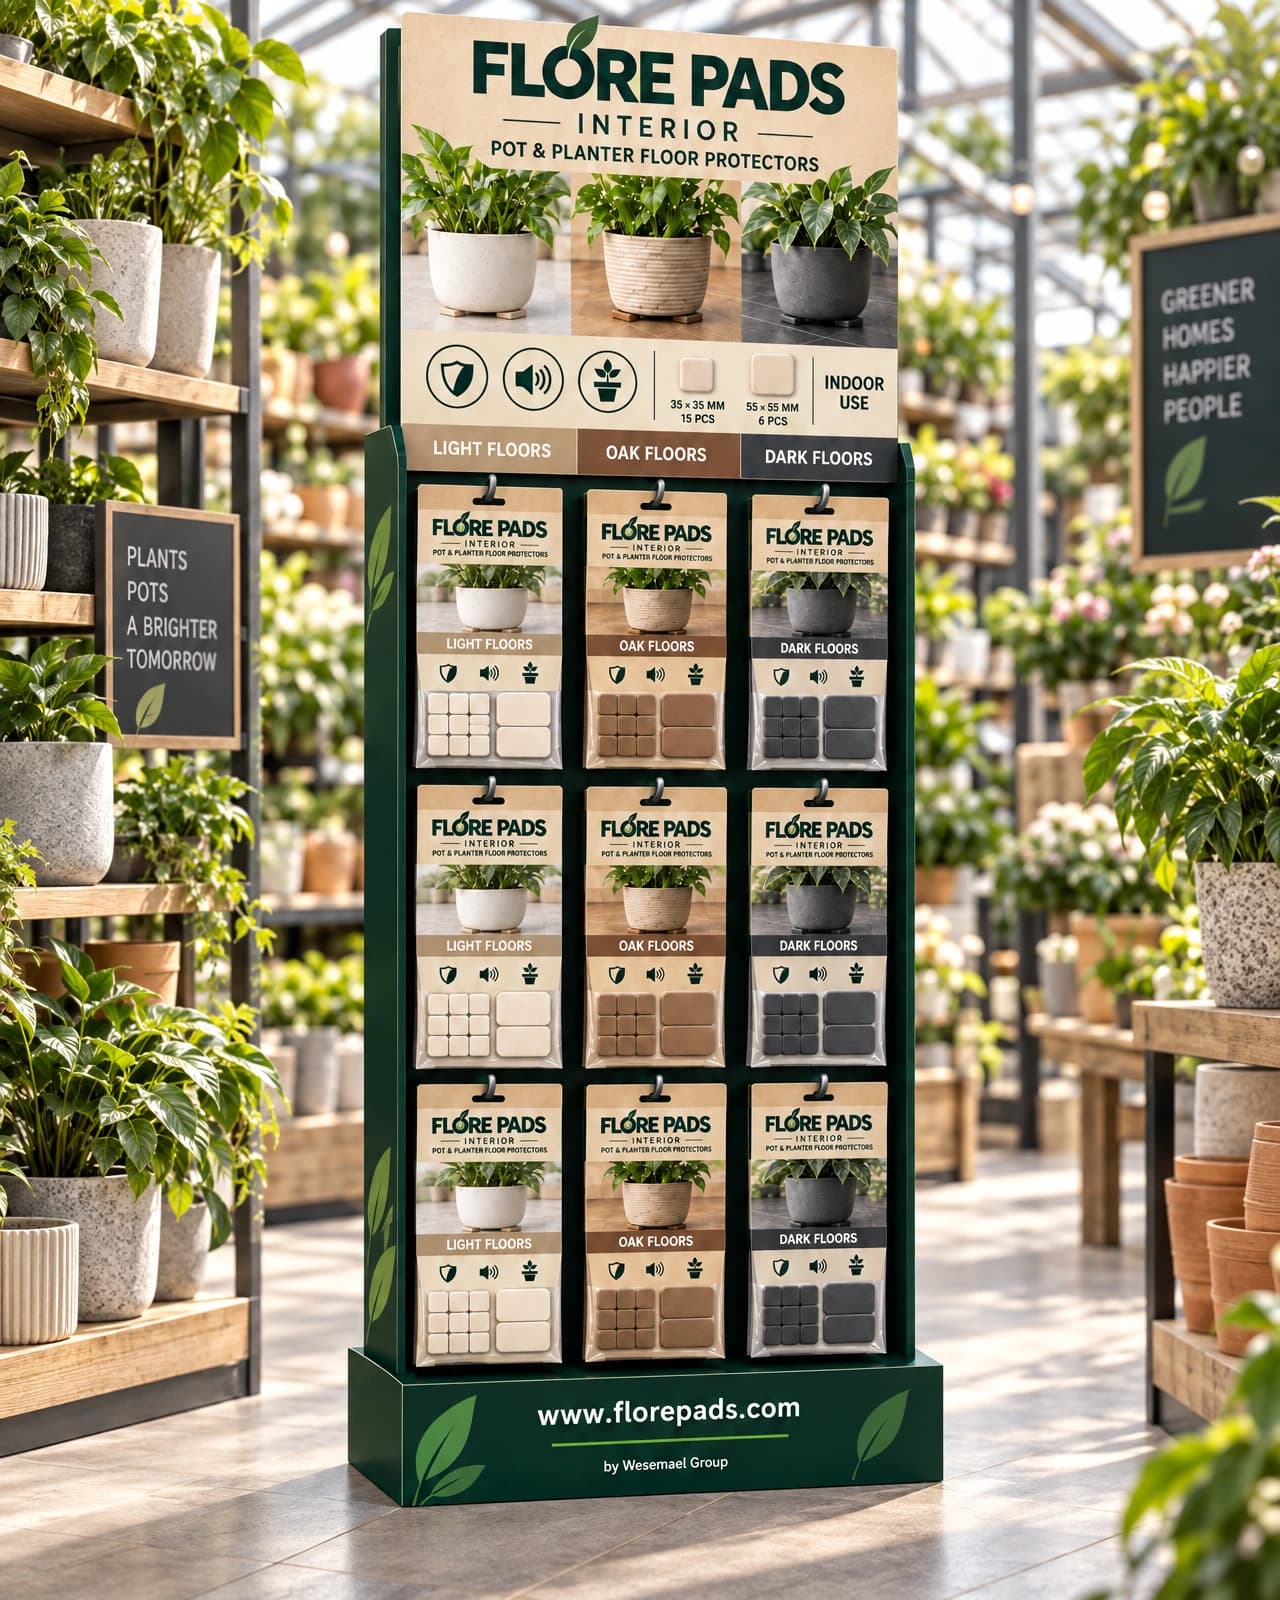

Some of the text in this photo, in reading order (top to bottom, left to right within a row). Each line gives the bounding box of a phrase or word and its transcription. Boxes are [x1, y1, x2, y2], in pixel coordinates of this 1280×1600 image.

[473, 40, 845, 115] FLORE PADS
[578, 112, 738, 142] INTERIOR
[491, 140, 819, 173] POT & PLANTER FLOOR PROTECTORS
[1160, 276, 1256, 315] GREENER
[1162, 317, 1235, 351] HOMES
[1163, 353, 1251, 387] HAPPIER
[825, 375, 884, 391] INDOOR
[670, 400, 683, 409] 35
[692, 400, 705, 410] 35
[707, 401, 725, 411] MM
[746, 402, 758, 412] 55
[768, 402, 779, 412] 55
[781, 403, 799, 413] MM
[840, 395, 869, 410] USE
[1163, 392, 1242, 424] PEOPLE
[681, 414, 715, 424] 15 PCS
[758, 416, 788, 426] 6 PCS
[433, 440, 551, 458] LIGHT FLOORS
[606, 445, 707, 462] OAK FLOORS
[765, 449, 873, 466] DARK FLOORS
[432, 518, 548, 539] FLORE PADS
[601, 523, 712, 543] FLORE PADS
[766, 527, 874, 547] FLORE PADS
[465, 540, 515, 549] INTERIOR
[632, 544, 681, 552] INTERIOR
[128, 545, 188, 571] PLANTS
[128, 580, 169, 603] POTS
[126, 615, 218, 640] A BRIGHTER
[446, 638, 533, 651] LIGHT FLOORS
[619, 640, 695, 652] OAK FLOORS
[780, 642, 859, 655] DARK FLOORS
[126, 648, 217, 672] TOMORROW
[432, 819, 547, 837] FLORE PADS
[601, 820, 712, 838] FLORE PADS
[765, 821, 873, 839] FLORE PADS
[464, 840, 515, 848] INTERIOR
[632, 841, 681, 849] INTERIOR
[446, 940, 532, 952] LIGHT FLOORS
[619, 940, 694, 951] OAK FLOORS
[780, 940, 858, 951] DARK FLOORS
[432, 1116, 547, 1134] FLORE PADS
[600, 1116, 711, 1134] FLORE PADS
[765, 1114, 872, 1132] FLORE PADS
[464, 1137, 515, 1145] INTERIOR
[632, 1136, 681, 1144] INTERIOR
[796, 1135, 843, 1143] INTERIOR
[446, 1238, 532, 1251] LIGHT FLOORS
[618, 1235, 694, 1248] OAK FLOORS
[780, 1232, 858, 1245] DARK FLOORS
[538, 1398, 800, 1427] www.florepads.com
[603, 1457, 728, 1475] by Wesemael Group
